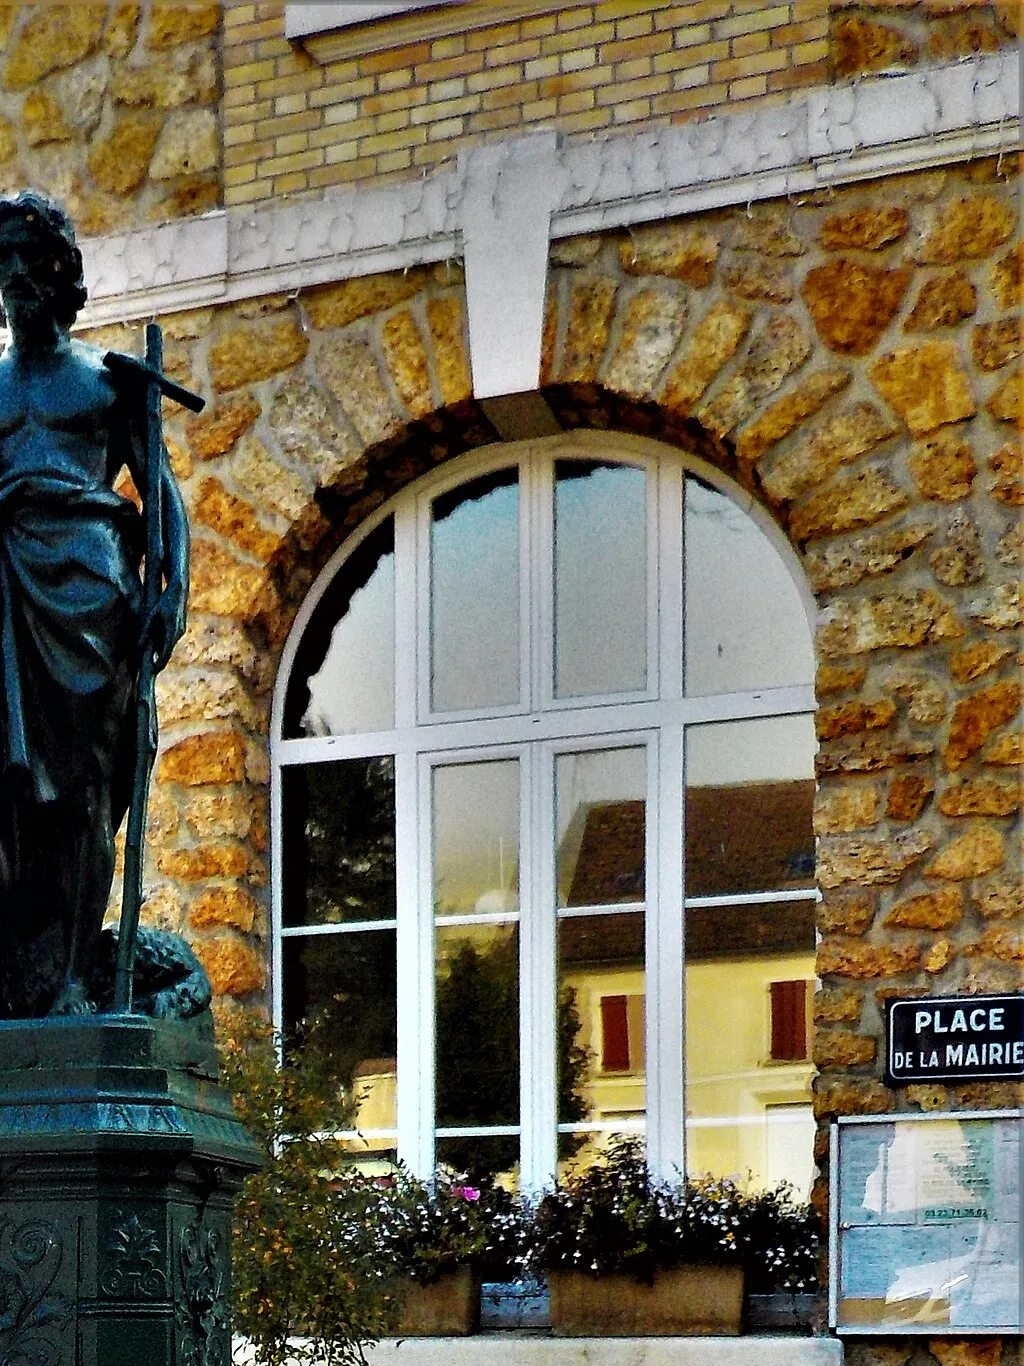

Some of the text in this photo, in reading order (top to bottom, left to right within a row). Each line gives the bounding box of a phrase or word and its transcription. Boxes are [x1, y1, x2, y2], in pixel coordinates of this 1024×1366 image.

[915, 1007, 1005, 1034] PLACE
[894, 1041, 1024, 1069] DE LA MAIRIE
